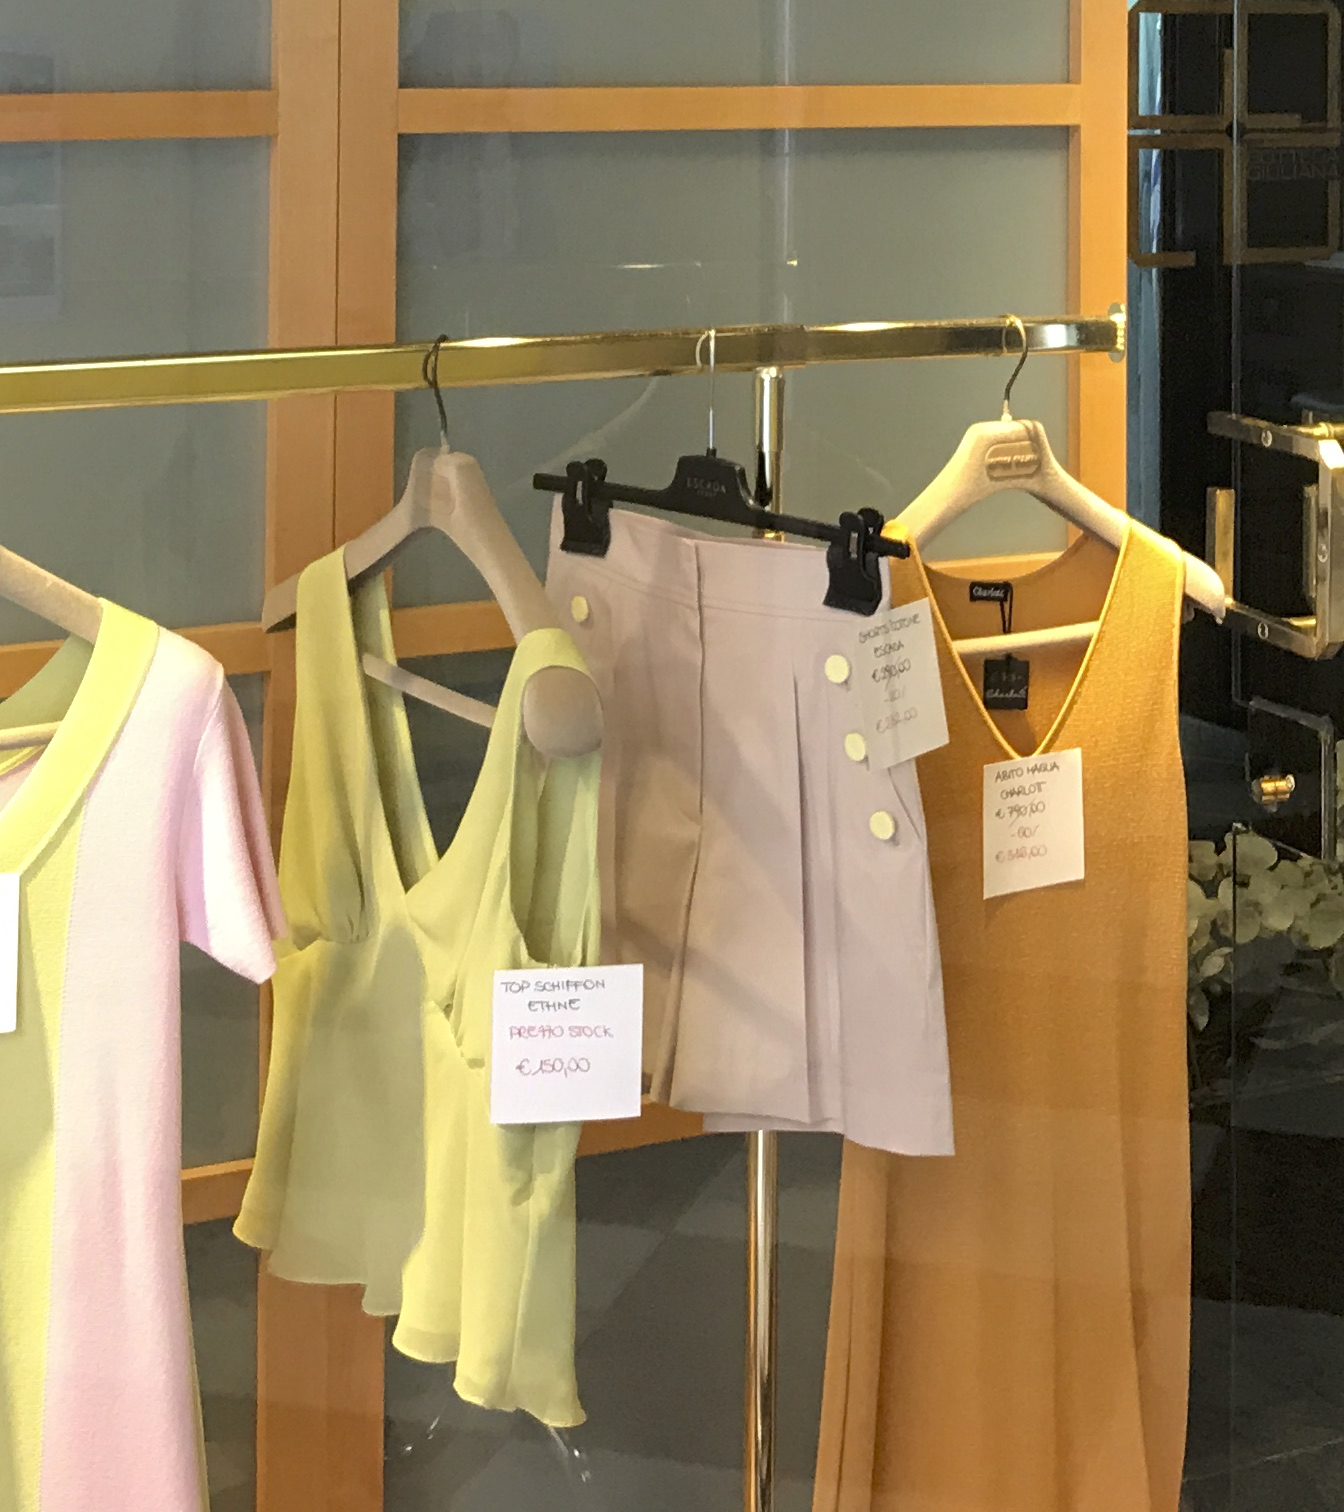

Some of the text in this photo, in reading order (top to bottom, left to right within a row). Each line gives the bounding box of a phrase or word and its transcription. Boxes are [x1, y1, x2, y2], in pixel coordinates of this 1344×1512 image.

[499, 978, 606, 994] TOP SCHIFFON
[568, 1025, 615, 1039] STOCK
